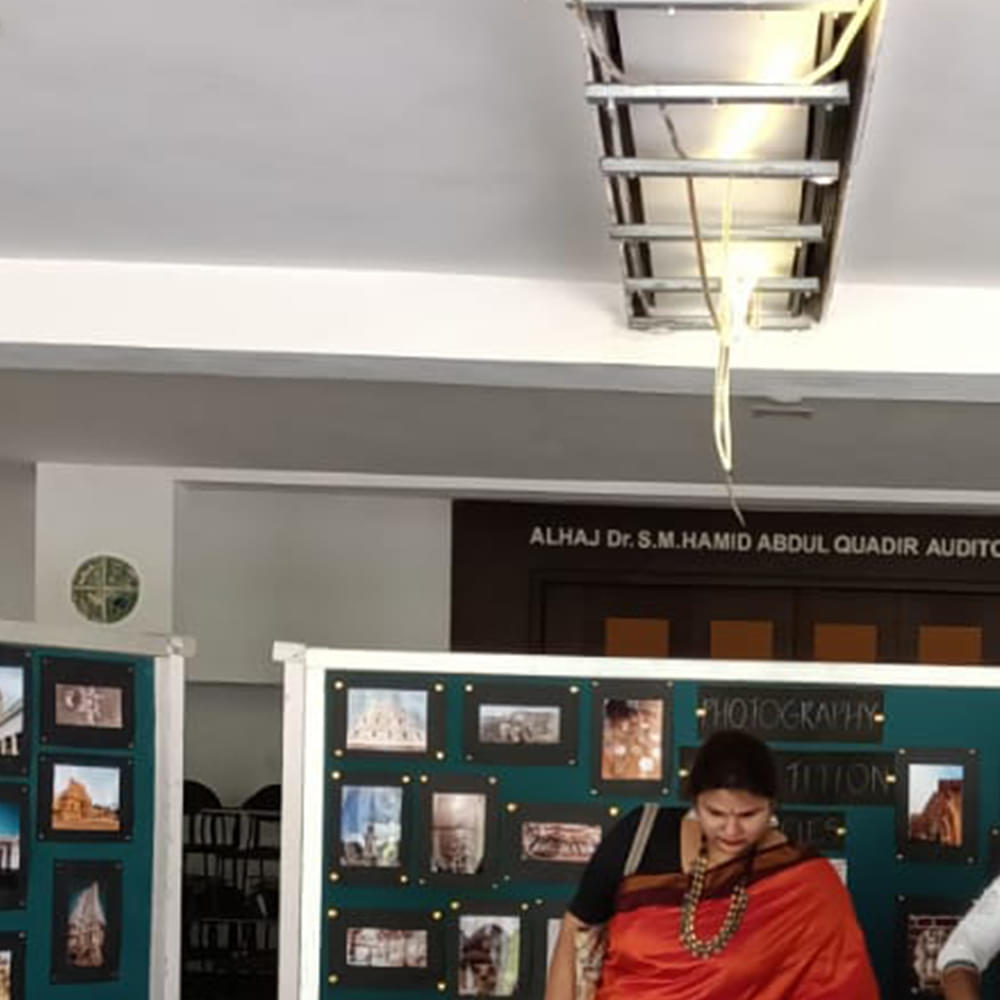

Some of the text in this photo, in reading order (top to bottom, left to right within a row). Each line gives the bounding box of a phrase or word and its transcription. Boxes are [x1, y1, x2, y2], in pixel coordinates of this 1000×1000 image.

[529, 526, 600, 547] ALHAJ
[606, 528, 634, 548] Dr.
[756, 532, 830, 554] ABDUL
[833, 534, 919, 556] QUADIR
[702, 696, 880, 733] PHOTOGRAPHY
